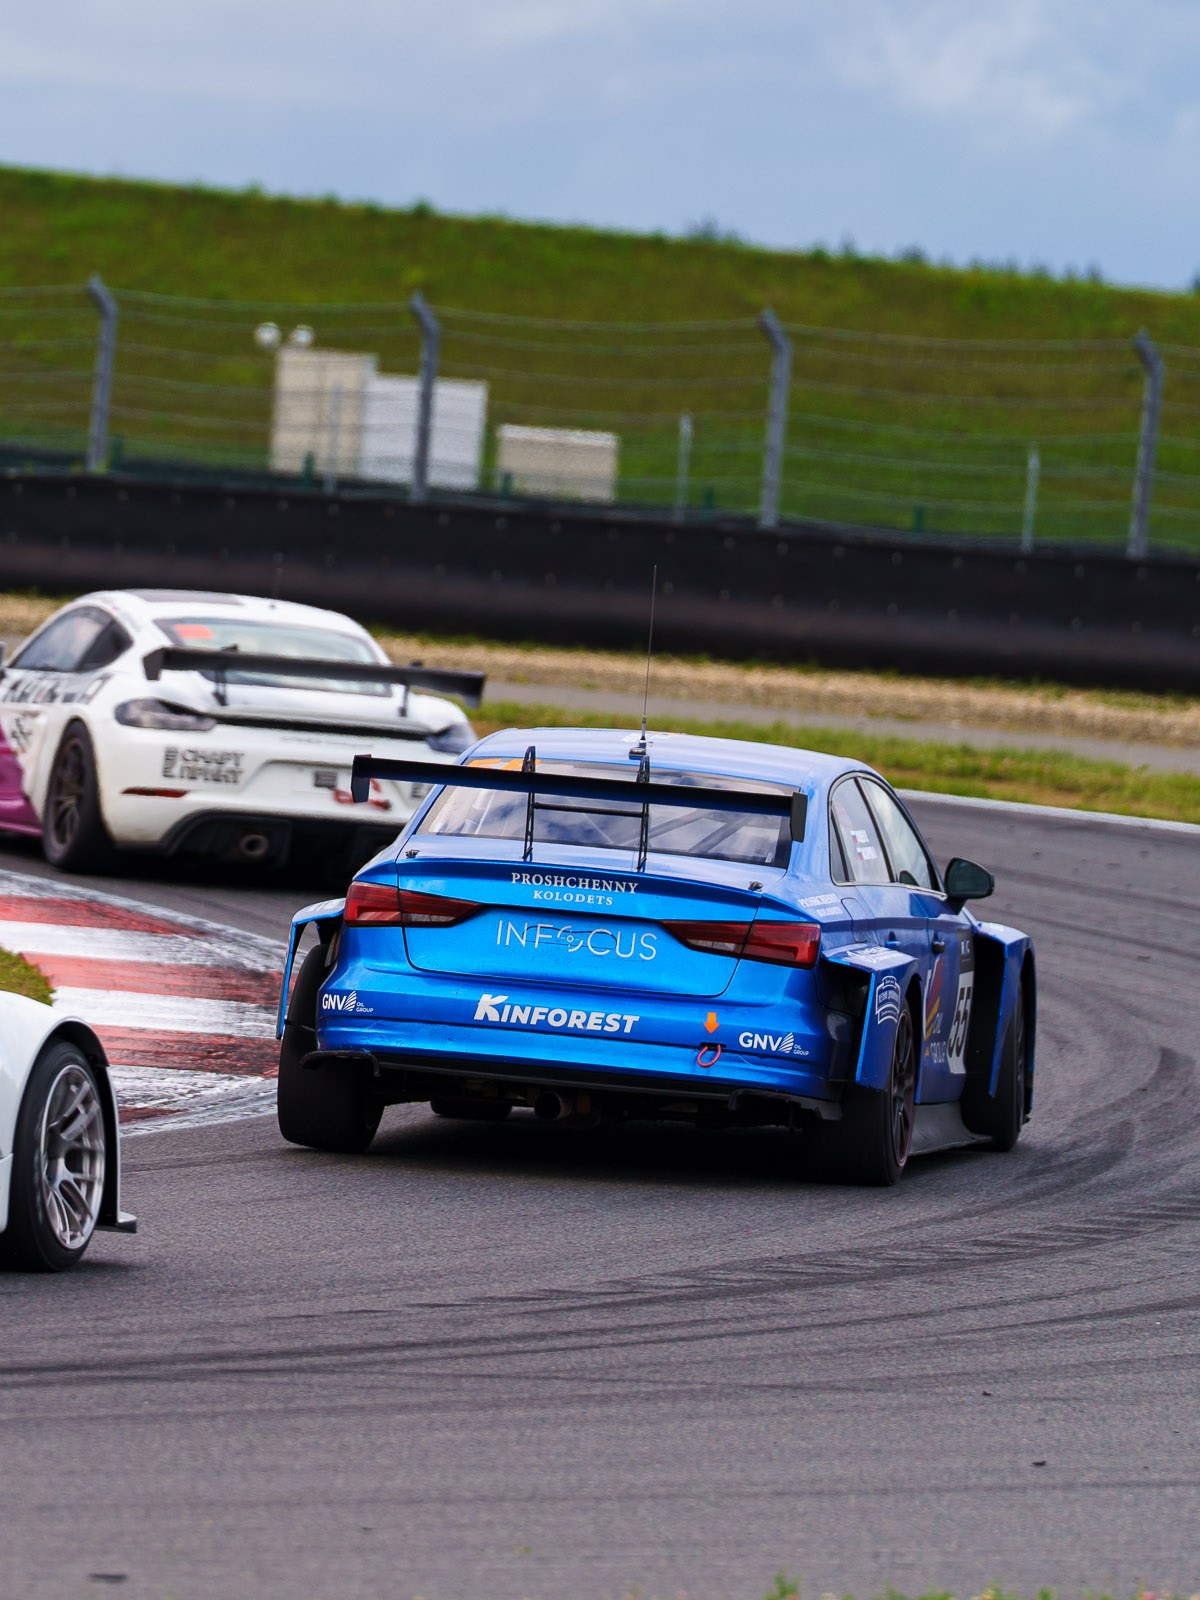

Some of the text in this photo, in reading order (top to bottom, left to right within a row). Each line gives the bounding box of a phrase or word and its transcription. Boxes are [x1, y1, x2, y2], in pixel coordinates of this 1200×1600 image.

[511, 872, 639, 894] PROSHCHENNY
[533, 890, 613, 906] KOLODETS
[322, 993, 347, 1011] GNV
[473, 993, 640, 1033] KINFOREST
[947, 986, 972, 1058] 55
[738, 1031, 782, 1051] GNV
